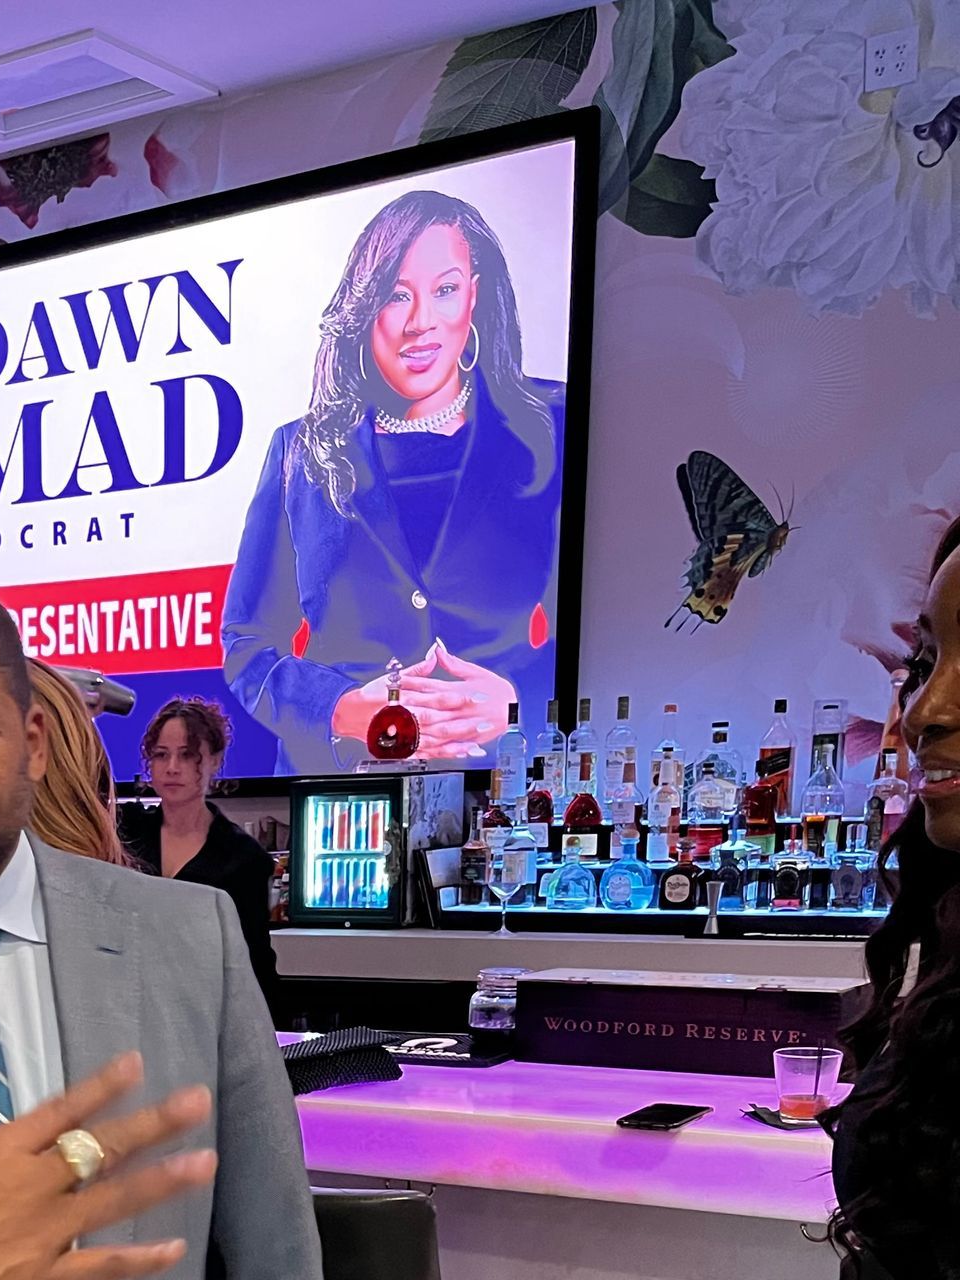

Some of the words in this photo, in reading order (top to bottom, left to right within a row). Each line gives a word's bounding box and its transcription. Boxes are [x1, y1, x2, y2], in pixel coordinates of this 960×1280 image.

[8, 591, 213, 657] ESENTATIVE
[544, 1016, 675, 1038] WOODFORD
[685, 1023, 801, 1044] RESERVE
